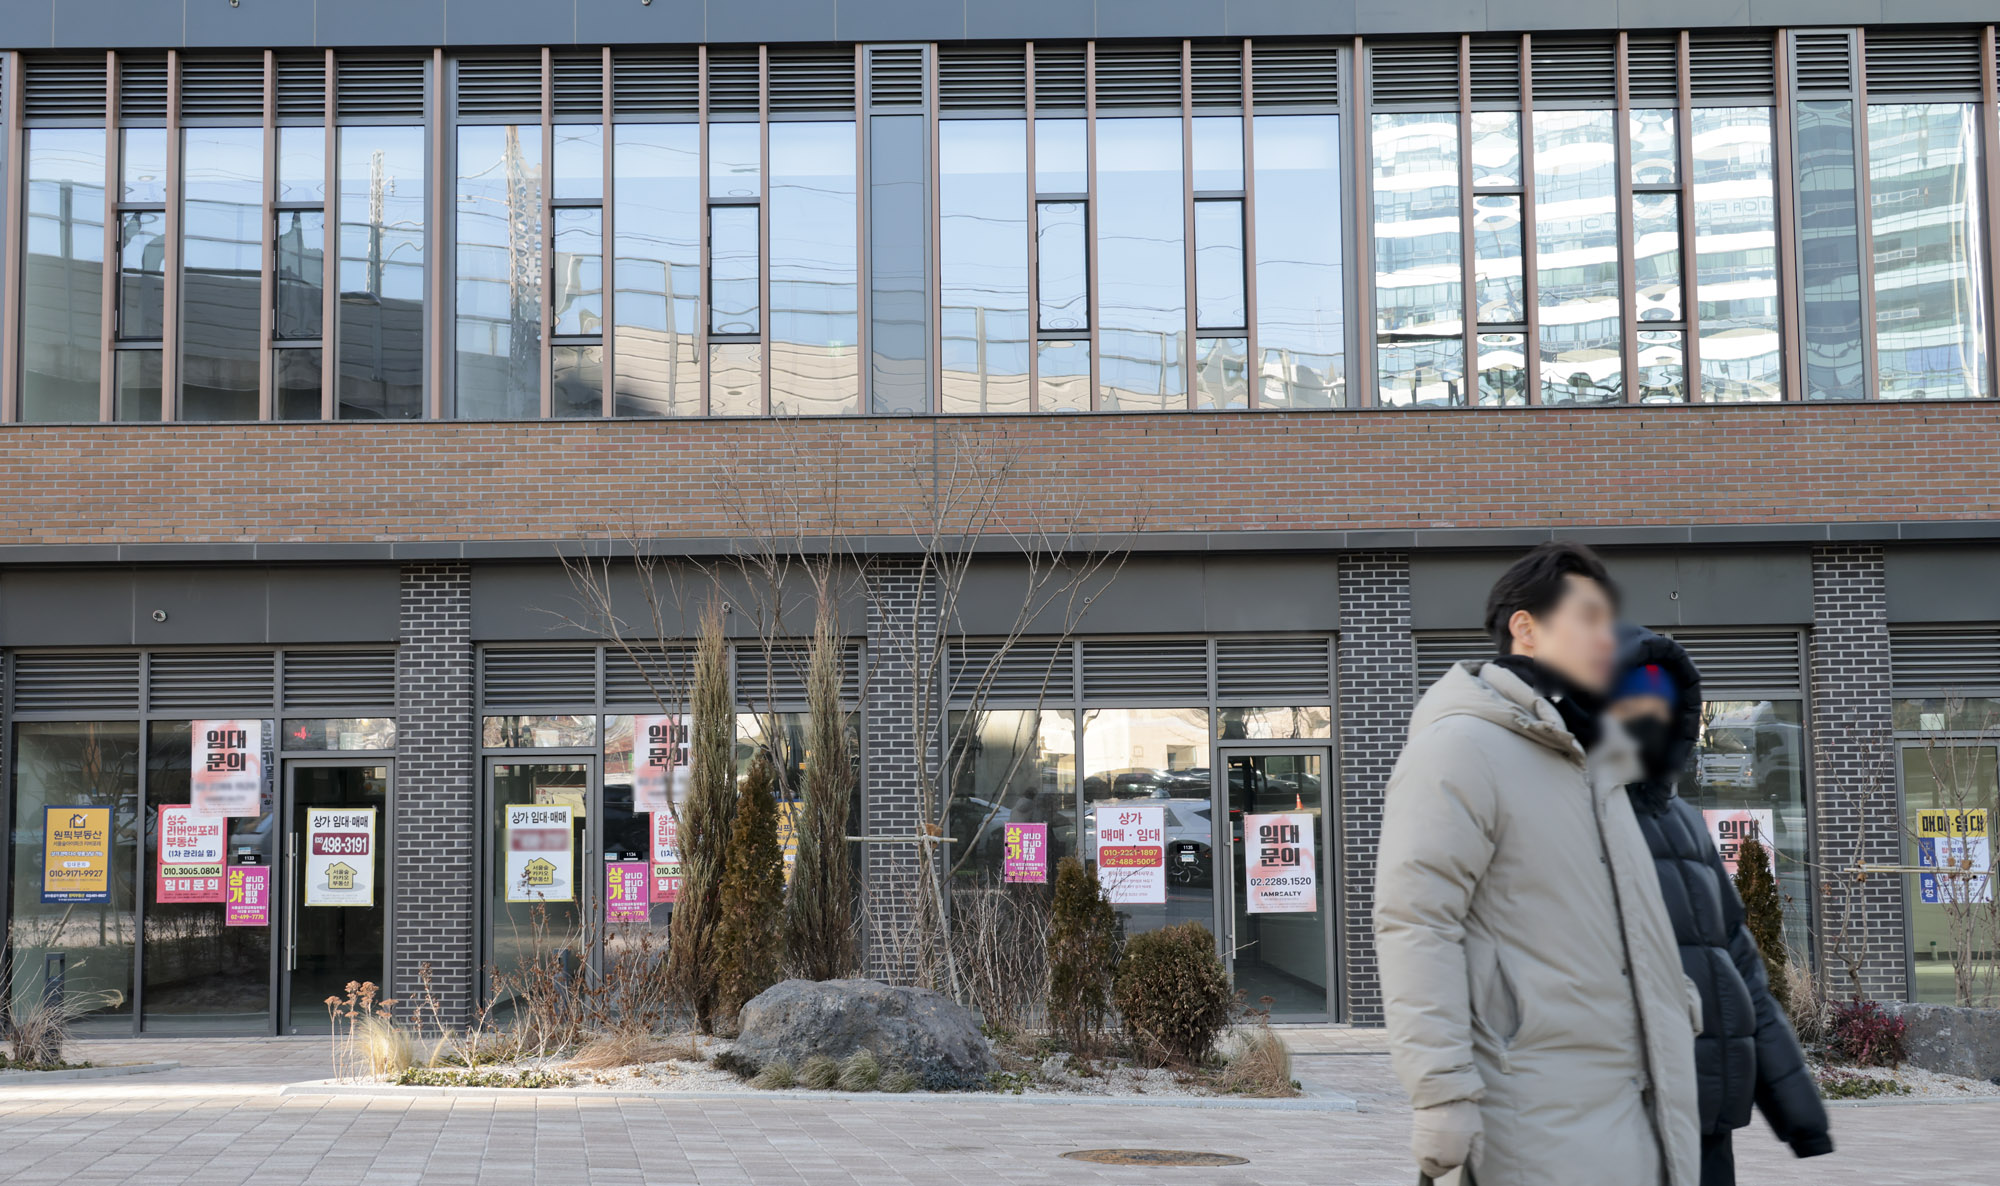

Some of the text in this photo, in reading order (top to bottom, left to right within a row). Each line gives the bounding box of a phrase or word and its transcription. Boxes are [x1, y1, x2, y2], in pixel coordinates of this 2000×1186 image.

[207, 730, 246, 749] 임대
[649, 725, 688, 743] 임대
[206, 753, 246, 772] 문의
[648, 747, 688, 766] 문의
[167, 815, 187, 825] 성수
[314, 815, 331, 828] 상가
[512, 811, 528, 824] 상가
[1119, 812, 1142, 825] 상가
[54, 830, 102, 840] 원픽부동산
[167, 825, 219, 836] 리버앤포레
[1101, 829, 1124, 842] 매매
[1137, 828, 1160, 842] 임대
[1260, 825, 1300, 844] 임대
[1718, 820, 1759, 840] 임대
[167, 837, 198, 847] 부동산
[321, 836, 367, 853] 498-3191
[1260, 847, 1300, 867] 문의
[164, 867, 220, 875] 010.3005.0804
[1250, 877, 1312, 886] 02.2289.1520
